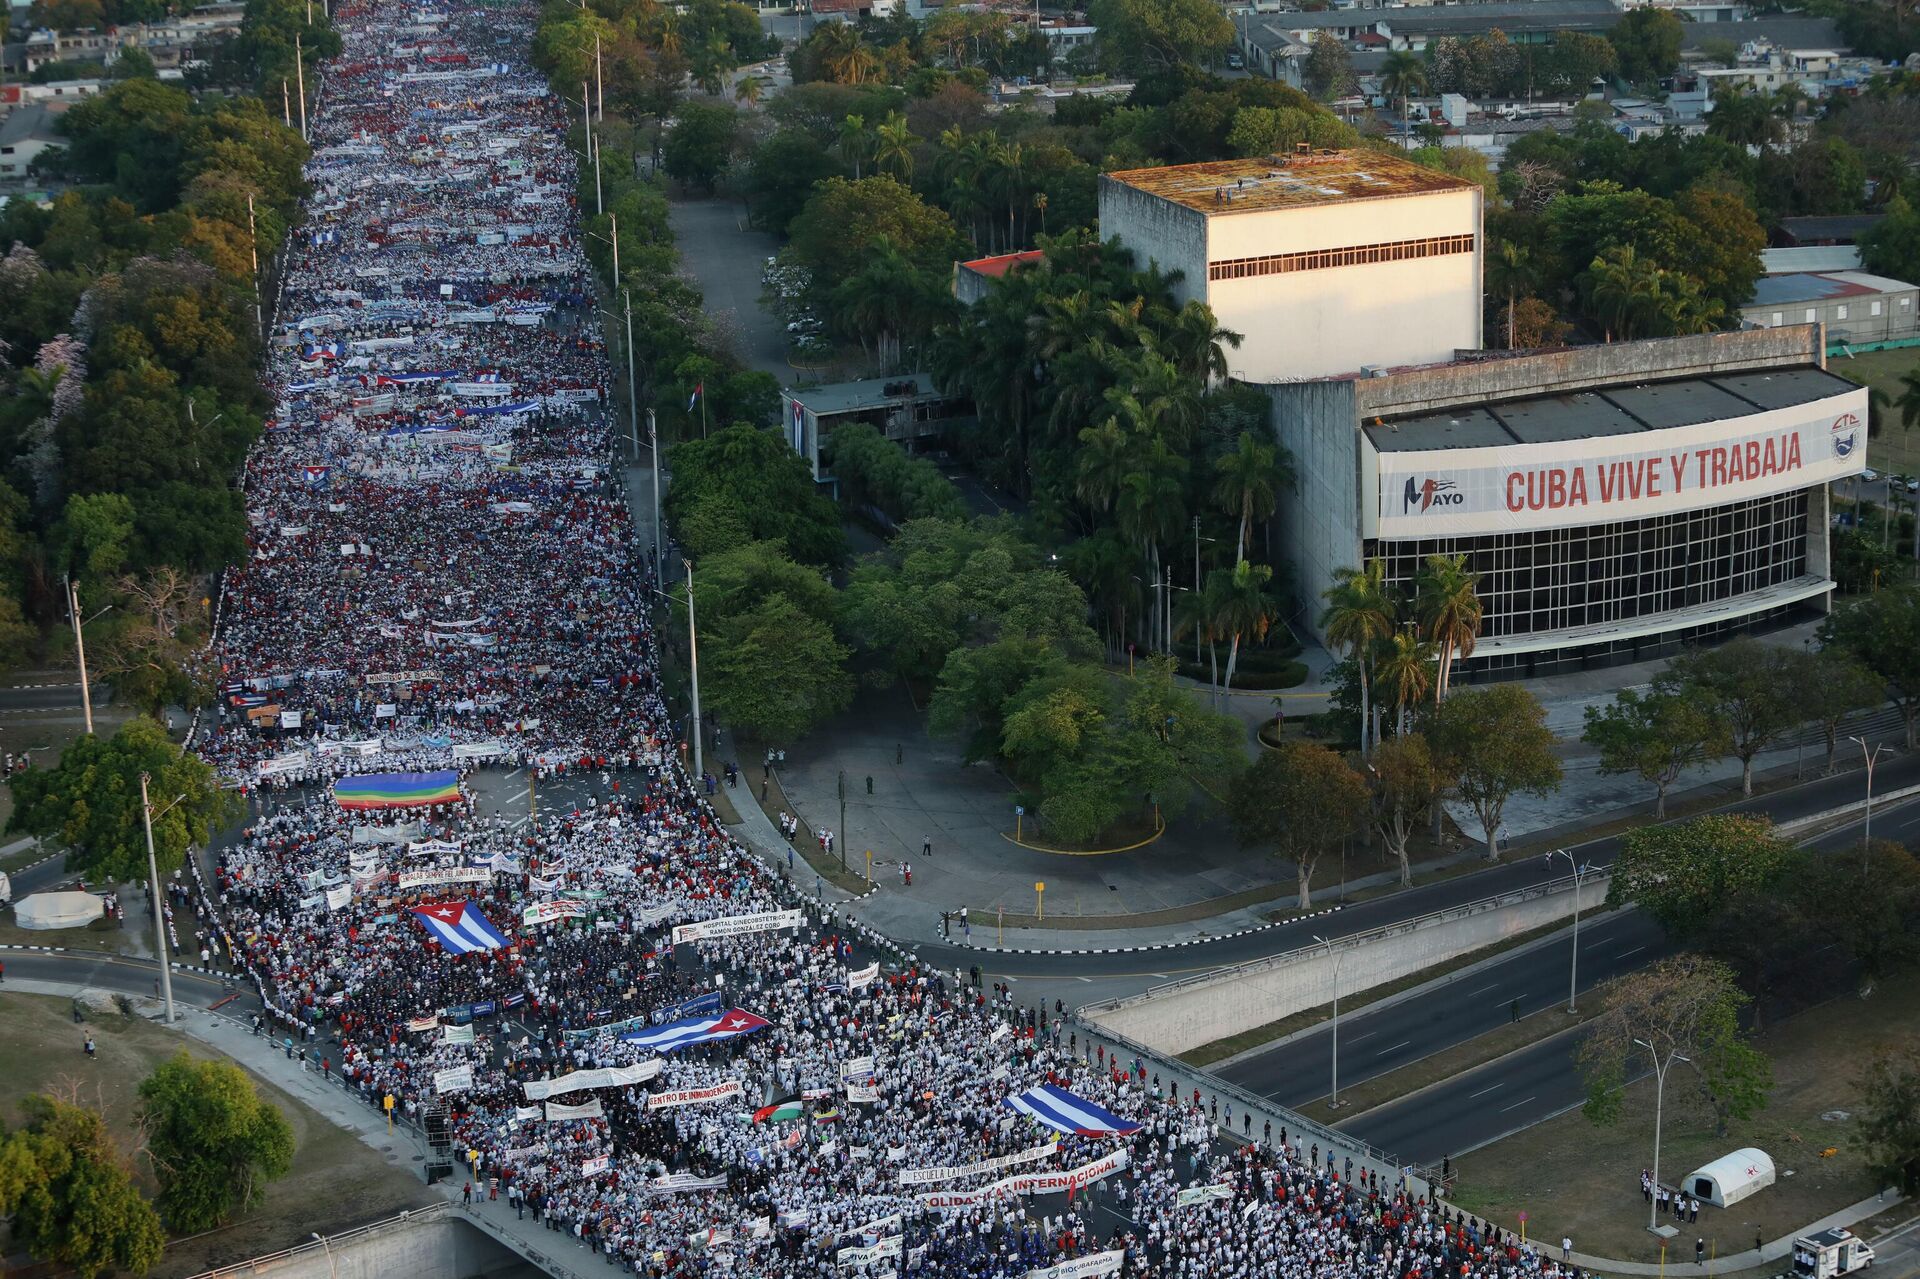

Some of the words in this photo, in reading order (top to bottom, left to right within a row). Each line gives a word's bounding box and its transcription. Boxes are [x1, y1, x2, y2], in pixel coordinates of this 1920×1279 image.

[1506, 466, 1589, 513] CUBA
[1597, 457, 1663, 504] VIVE
[1670, 452, 1688, 494] Y
[1695, 431, 1803, 490] TRABAJA
[404, 671, 412, 679] DE
[410, 845, 460, 854] CIREN
[703, 921, 732, 929] HOSPITAL
[733, 924, 764, 933] GONZÁLEZ
[679, 1092, 688, 1101] DE
[688, 1083, 739, 1100] INMUNOENSAYO
[913, 1168, 945, 1182] ESCUELA
[1013, 1159, 1118, 1190] INTERNACIONAL
[1060, 1256, 1113, 1274] BIOCUBAFARMA
